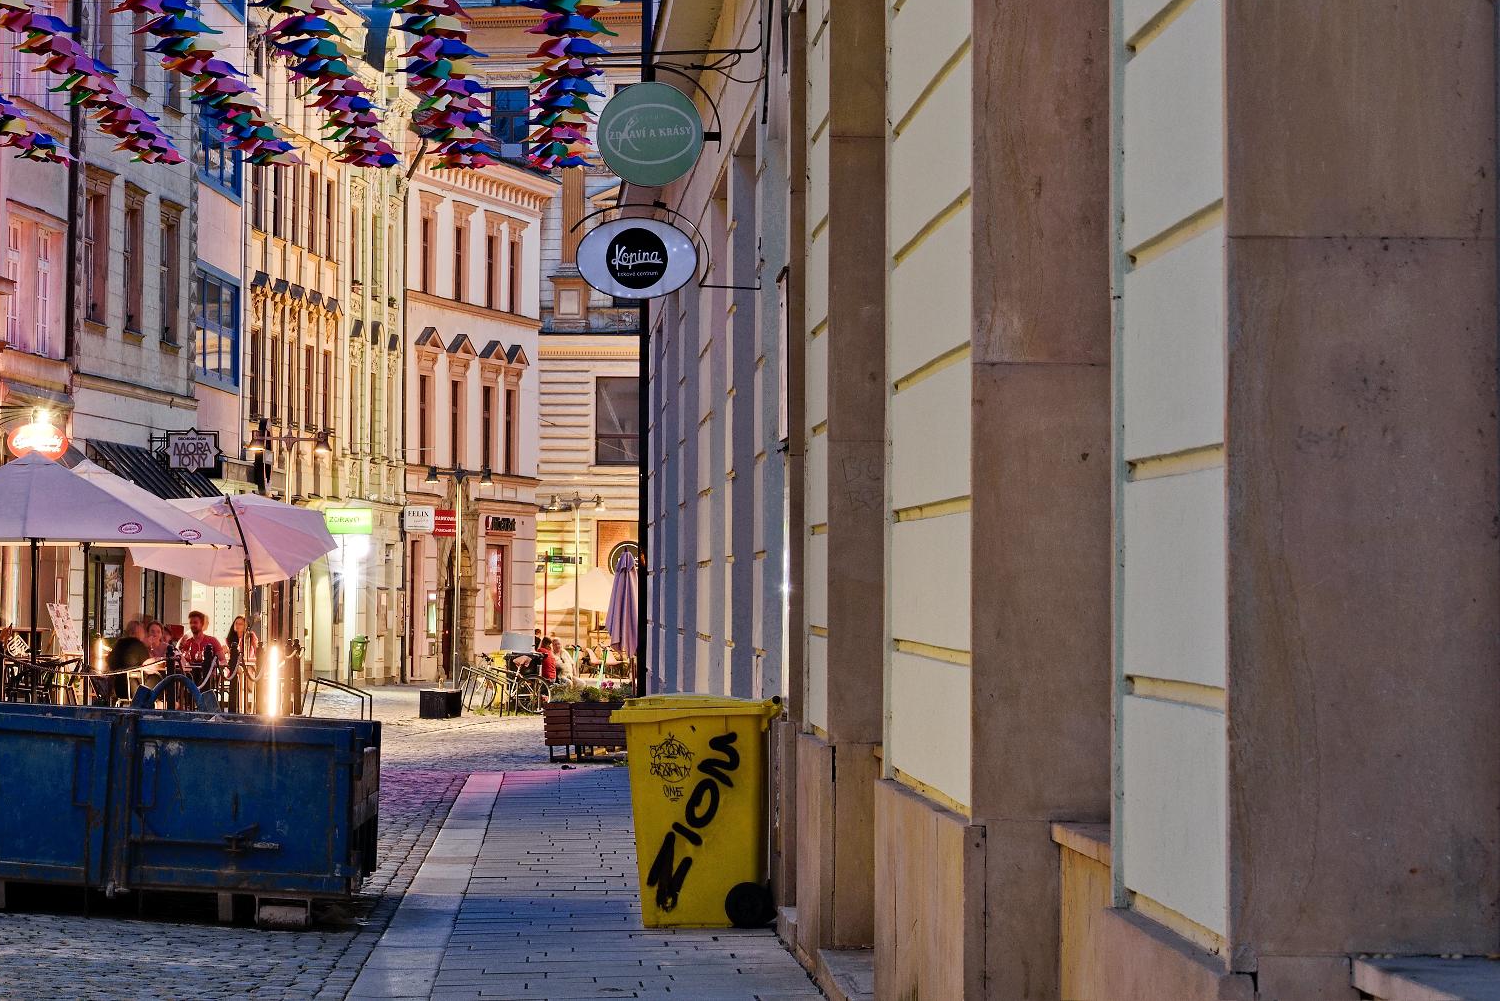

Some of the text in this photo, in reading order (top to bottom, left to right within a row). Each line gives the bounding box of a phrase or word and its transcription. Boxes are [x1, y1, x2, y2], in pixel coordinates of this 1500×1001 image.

[649, 129, 656, 138] A
[659, 124, 692, 137] KRÁSY
[173, 442, 212, 456] MORA
[176, 454, 208, 467] TONY
